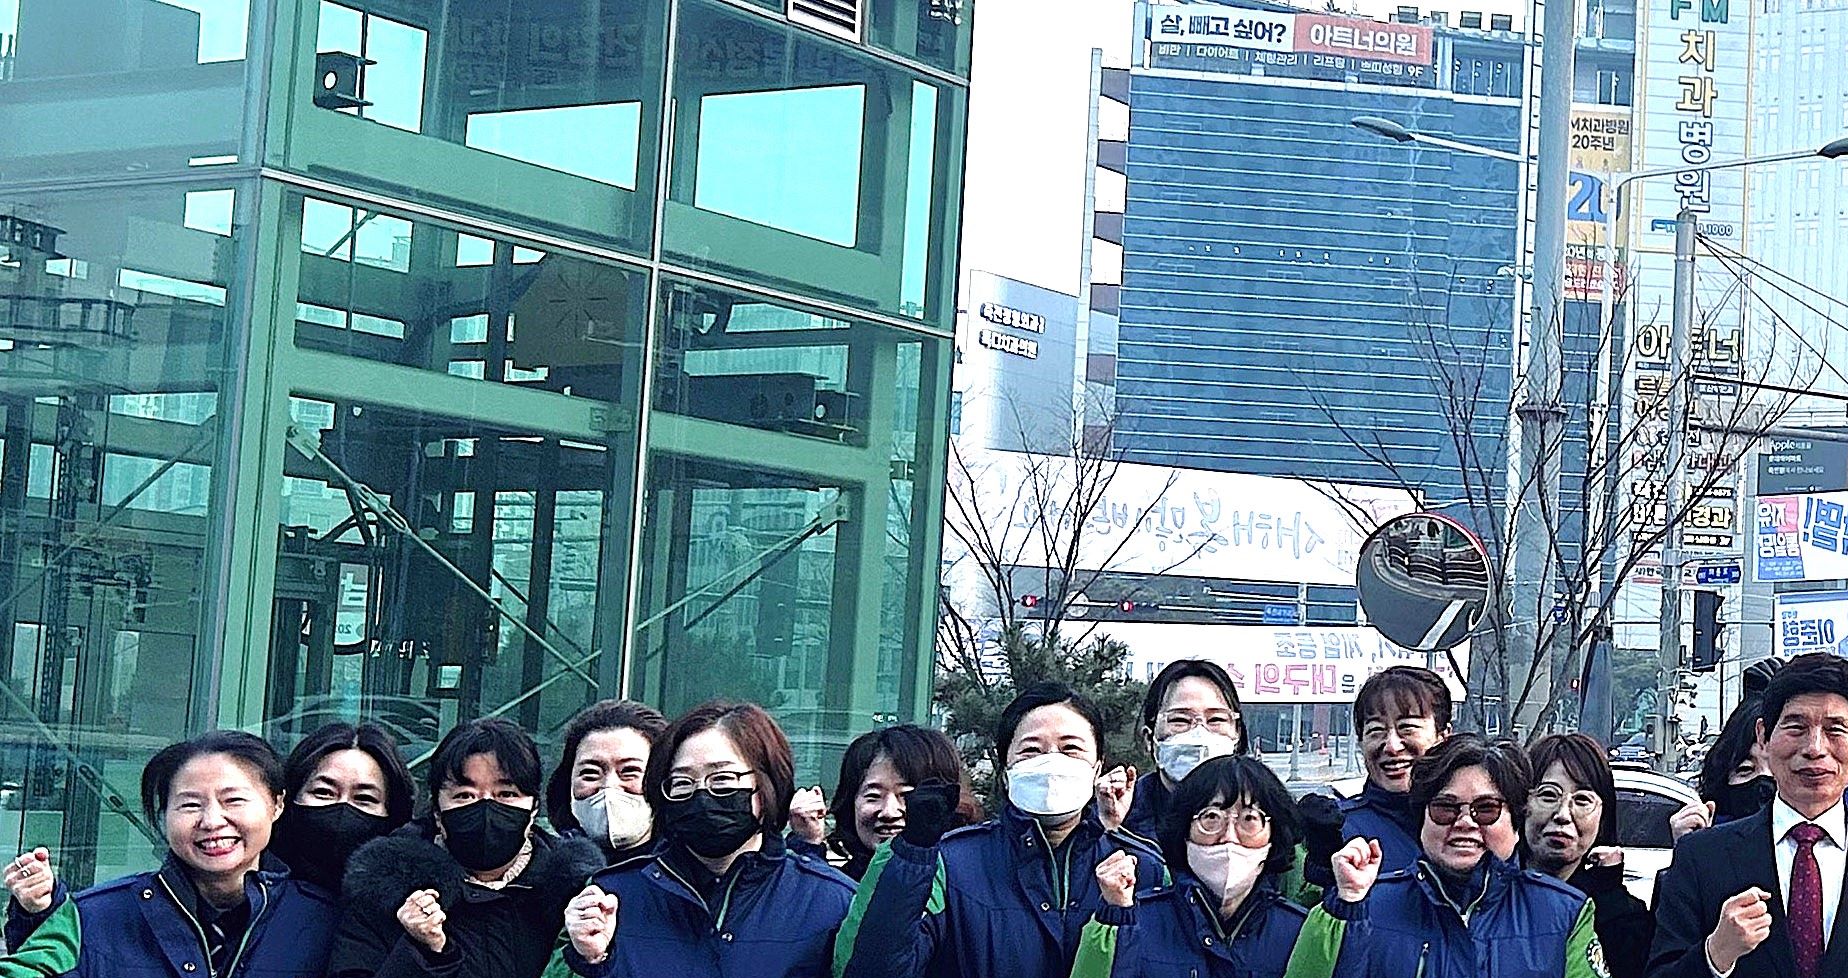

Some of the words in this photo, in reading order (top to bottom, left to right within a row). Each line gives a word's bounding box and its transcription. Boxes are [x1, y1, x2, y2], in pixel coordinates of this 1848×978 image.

[1160, 14, 1185, 36] 살,
[1188, 15, 1229, 36] 빼고
[1234, 18, 1287, 43] 싶어?
[1310, 23, 1418, 56] 아트너의원
